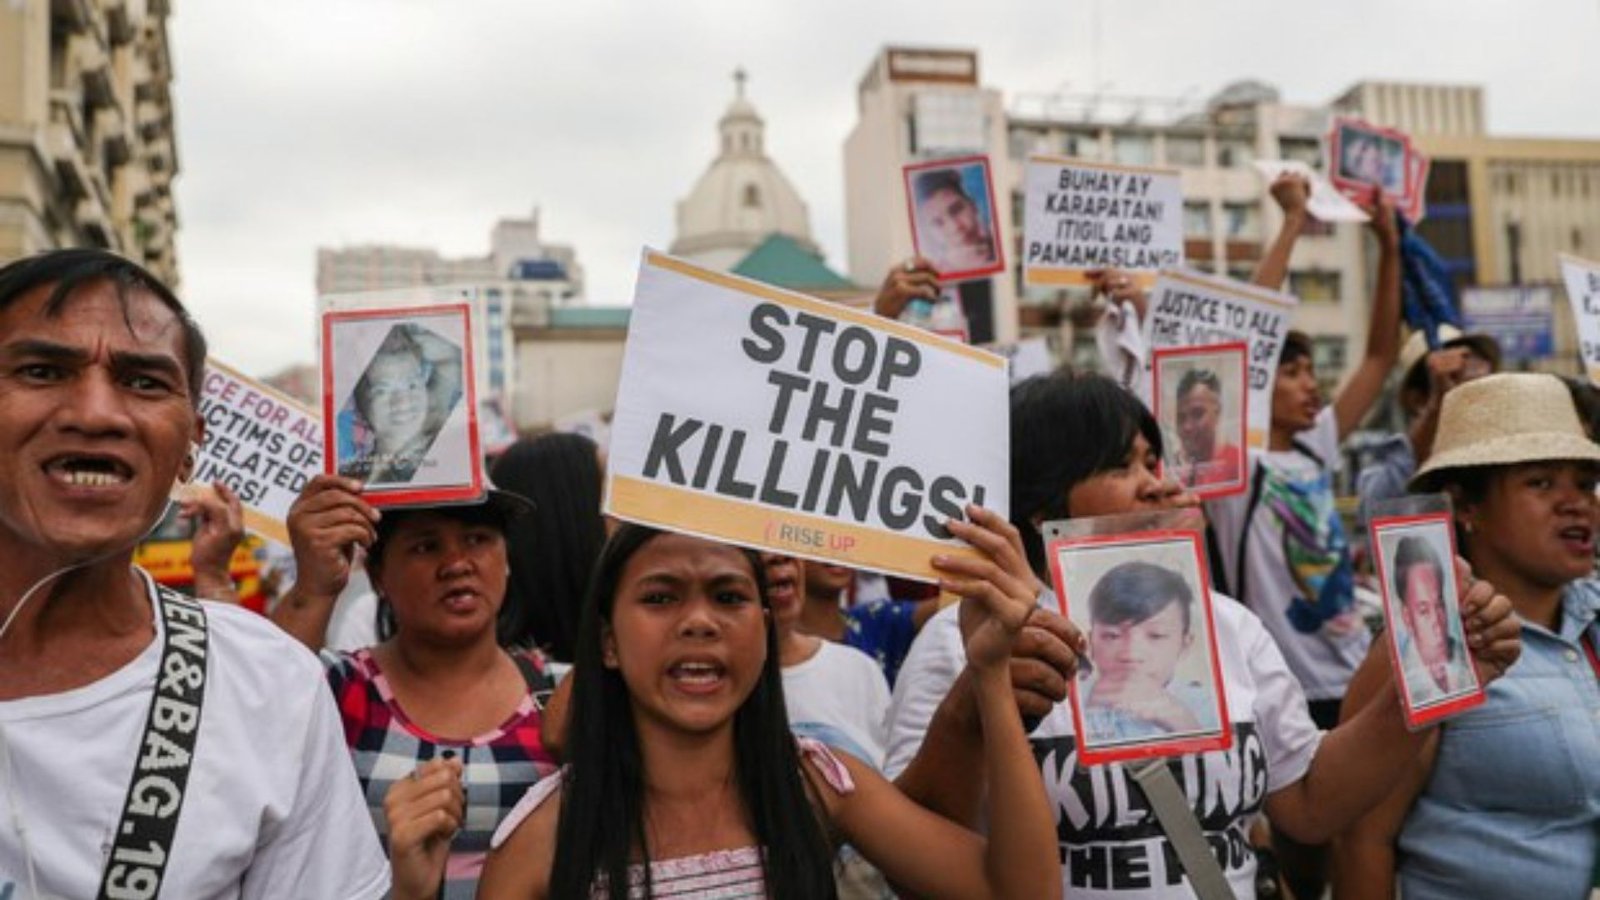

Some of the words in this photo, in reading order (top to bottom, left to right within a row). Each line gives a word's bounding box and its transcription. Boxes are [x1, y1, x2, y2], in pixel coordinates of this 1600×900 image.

[1059, 168, 1122, 192] BUHAY
[1126, 175, 1151, 197] AY
[1056, 219, 1108, 243] ITIGIL
[1113, 223, 1152, 246] ANG
[1156, 288, 1220, 324] JUSTICE
[1225, 301, 1246, 330] TO
[1249, 310, 1280, 338] ALL
[741, 303, 921, 392] STOP
[198, 398, 287, 455] ICTIMS
[288, 442, 322, 469] OF
[239, 389, 291, 428] FOR
[289, 416, 323, 448] AL
[767, 370, 899, 457] THE
[780, 523, 825, 548] RISE
[830, 533, 855, 552] UP
[1059, 845, 1152, 890] HE
